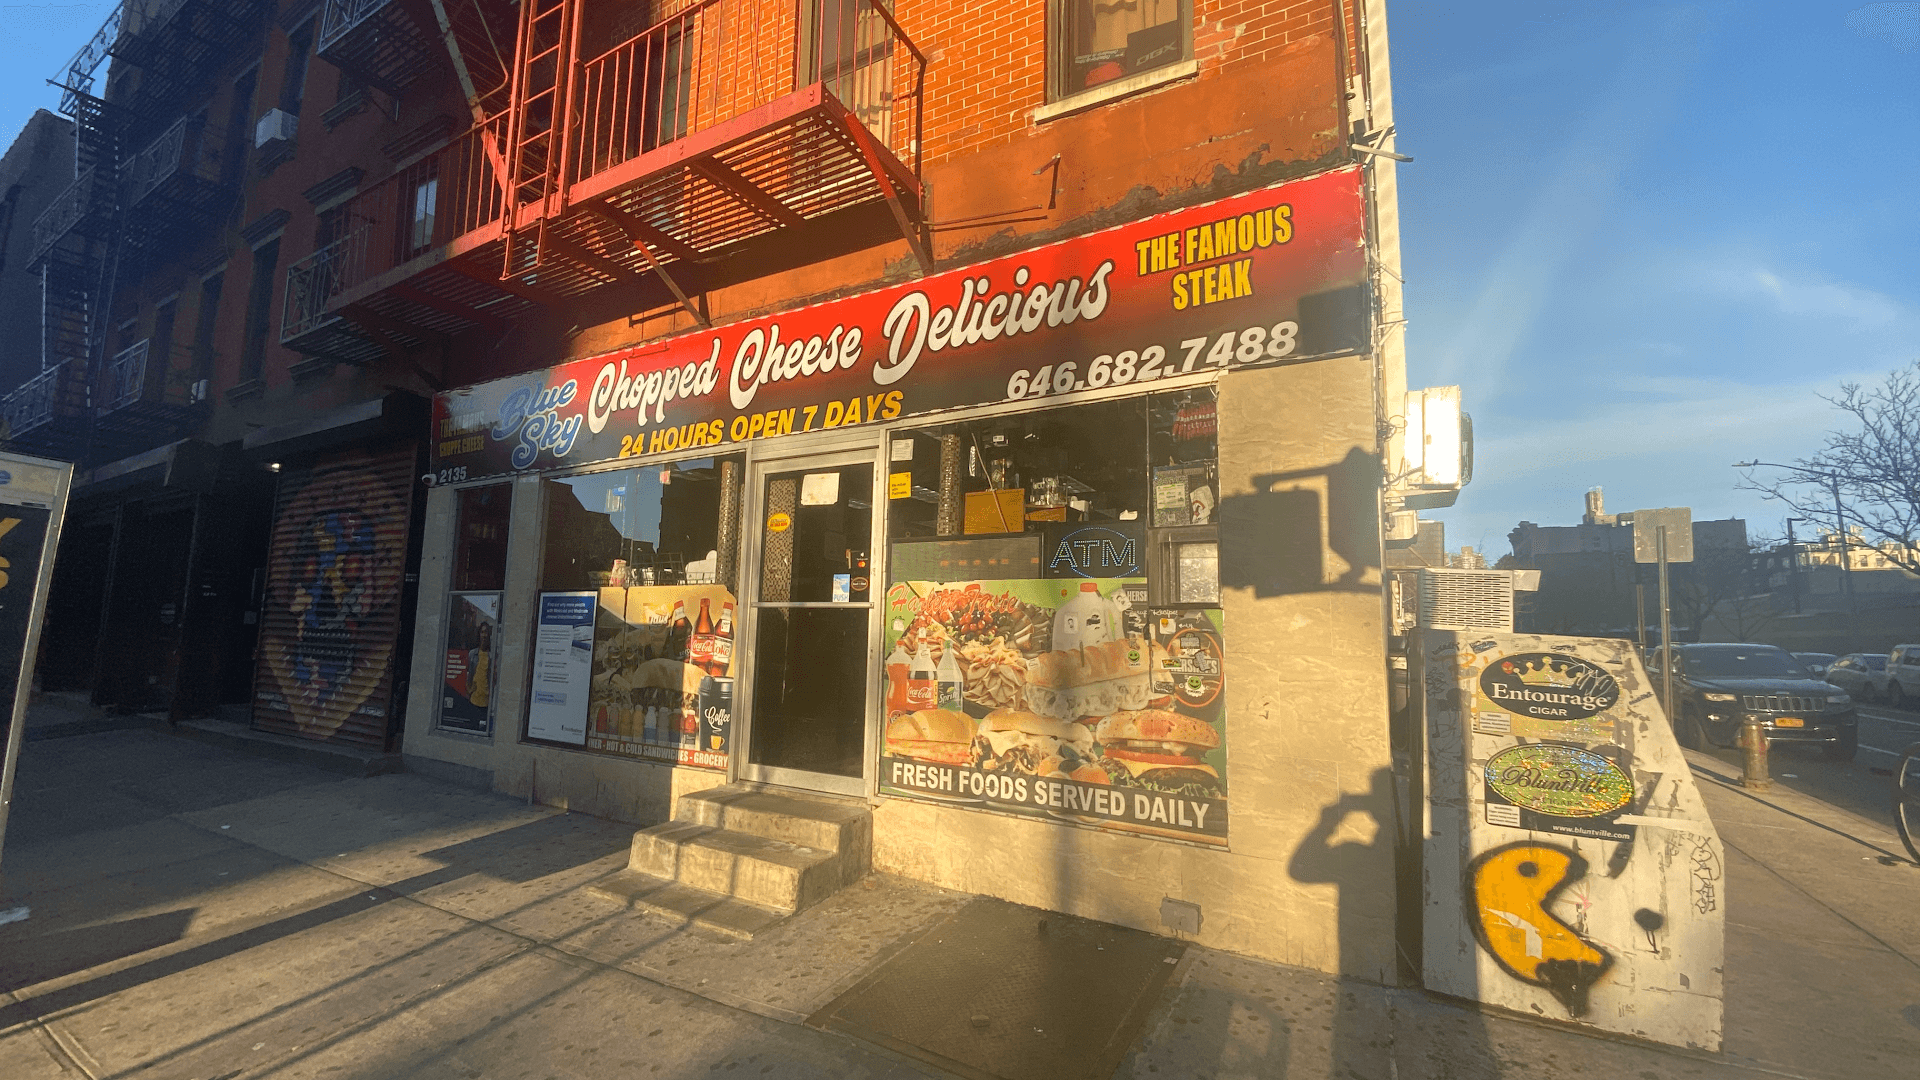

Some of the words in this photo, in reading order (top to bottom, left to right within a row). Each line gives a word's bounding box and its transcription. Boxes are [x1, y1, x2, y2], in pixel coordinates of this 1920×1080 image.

[1137, 235, 1180, 276] THE
[1186, 204, 1293, 263] FAMOUS
[1172, 259, 1253, 310] STEAK
[587, 336, 721, 434] Chopped
[729, 323, 863, 410] Cheese
[872, 259, 1114, 385] Delicious
[1006, 320, 1299, 401] 646.682.7488
[491, 378, 578, 441] Blue
[618, 433, 645, 458] 24
[648, 421, 724, 453] HOURS
[730, 406, 796, 441] OPEN
[801, 404, 820, 432] 7
[823, 390, 904, 430] DAYS
[511, 410, 584, 470] Sky
[439, 465, 467, 483] 2135
[1050, 538, 1136, 568] ATM
[887, 583, 956, 613] Harlem
[964, 583, 1019, 614] Taste
[704, 706, 731, 726] Coffee
[1491, 681, 1608, 710] Entourage
[1529, 705, 1568, 717] CIGAR
[625, 743, 643, 755] COLD
[643, 744, 689, 762] SANDWICHES
[694, 753, 729, 768] GROCERY
[892, 761, 953, 792] FRESH
[958, 769, 1028, 803] FOODS
[1034, 780, 1126, 817] SERVED
[1135, 795, 1210, 830] DAILY
[1552, 824, 1631, 840] www.bluntville.com
